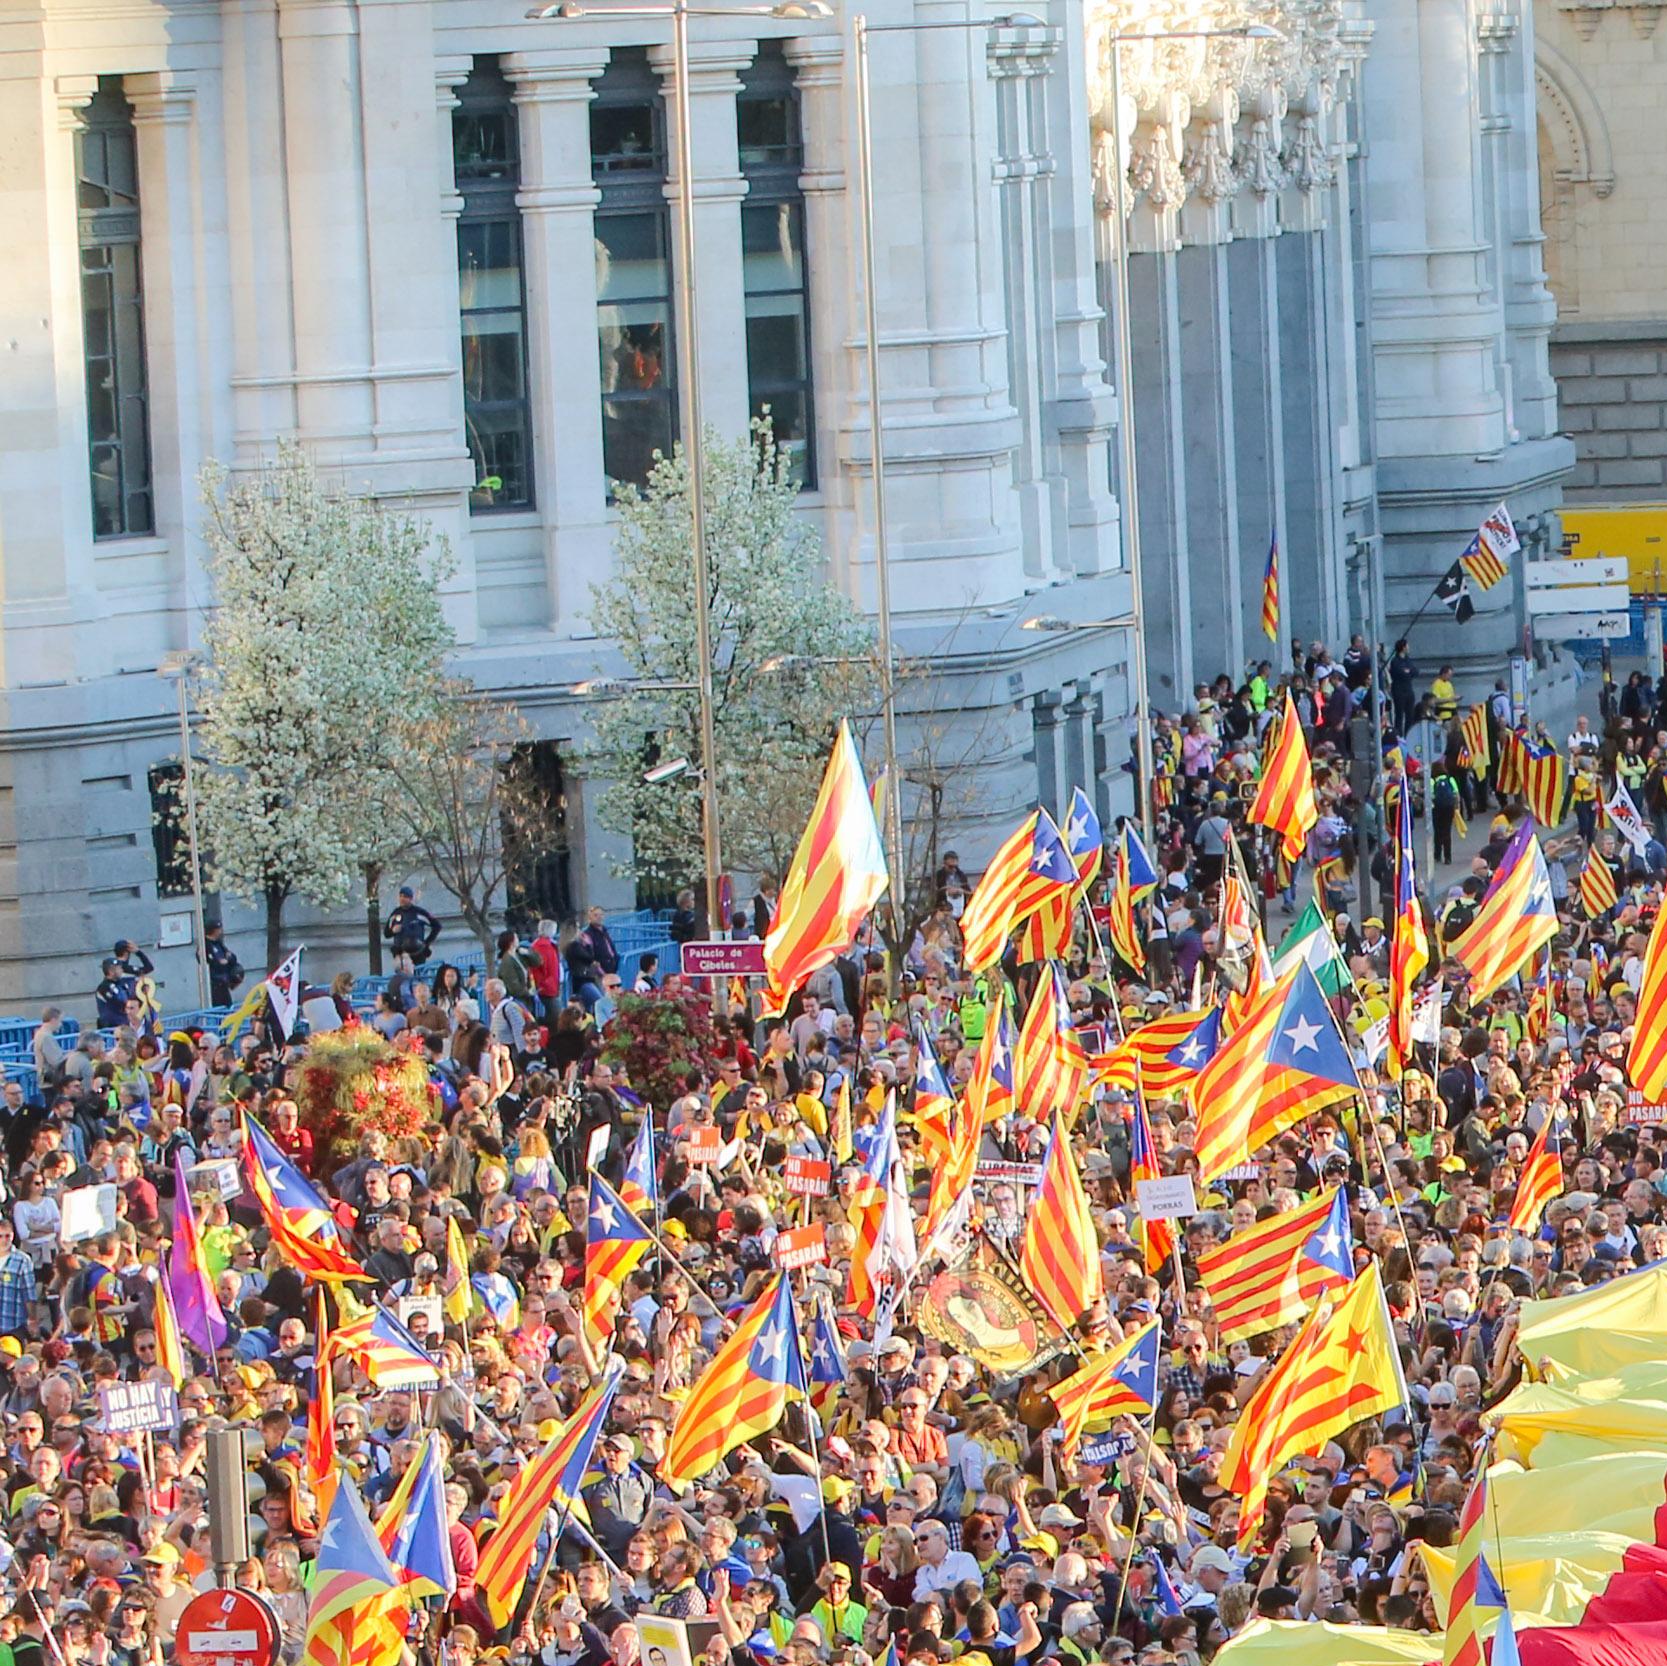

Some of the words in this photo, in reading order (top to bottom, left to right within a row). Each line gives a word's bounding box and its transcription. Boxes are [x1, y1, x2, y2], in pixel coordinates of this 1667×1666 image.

[689, 948, 725, 958] Palacio
[730, 949, 742, 957] de
[700, 960, 736, 970] Cibeles
[1628, 1091, 1642, 1104] NO
[787, 1158, 800, 1173] NO
[787, 1175, 828, 1194] PASARÁN
[777, 1234, 792, 1252] NO
[779, 1243, 825, 1269] PASARÁN
[108, 1387, 129, 1410] NO
[131, 1382, 157, 1407] HAY
